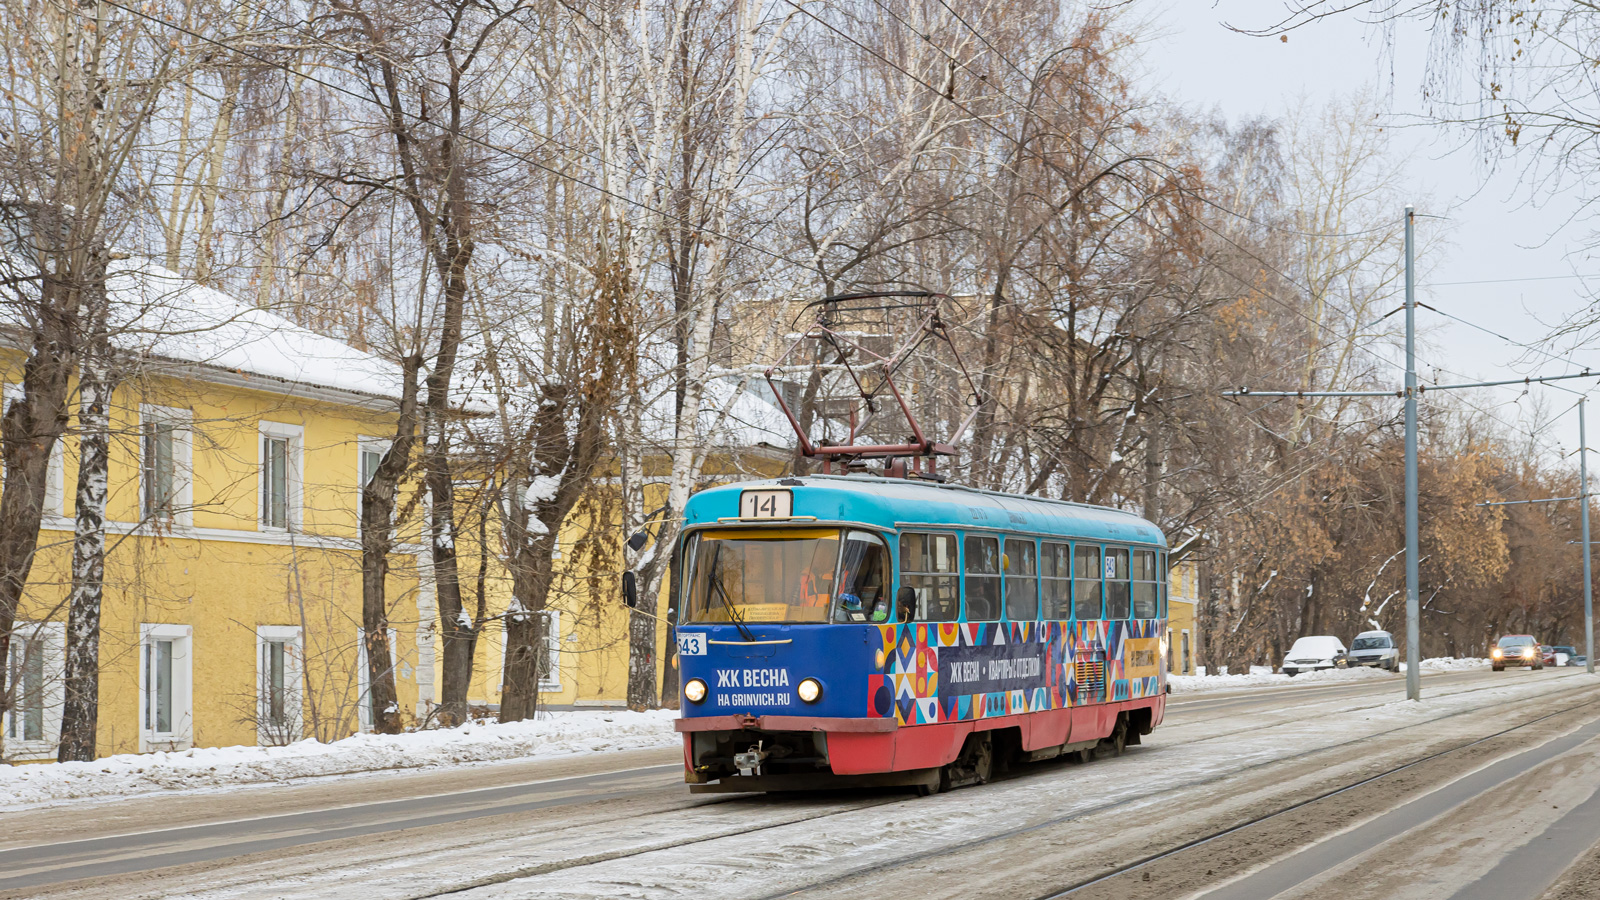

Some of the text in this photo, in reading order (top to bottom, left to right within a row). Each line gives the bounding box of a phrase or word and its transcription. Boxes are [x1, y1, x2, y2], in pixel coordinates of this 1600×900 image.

[750, 495, 776, 517] 14
[1106, 557, 1114, 573] 543
[716, 668, 789, 687] ЖК ВЕСНА
[950, 661, 963, 683] ЖК
[963, 661, 980, 682] ВЕСНА
[988, 659, 1013, 680] КВАРТИРЫ
[717, 692, 790, 706] НА GRINVICH.RU
